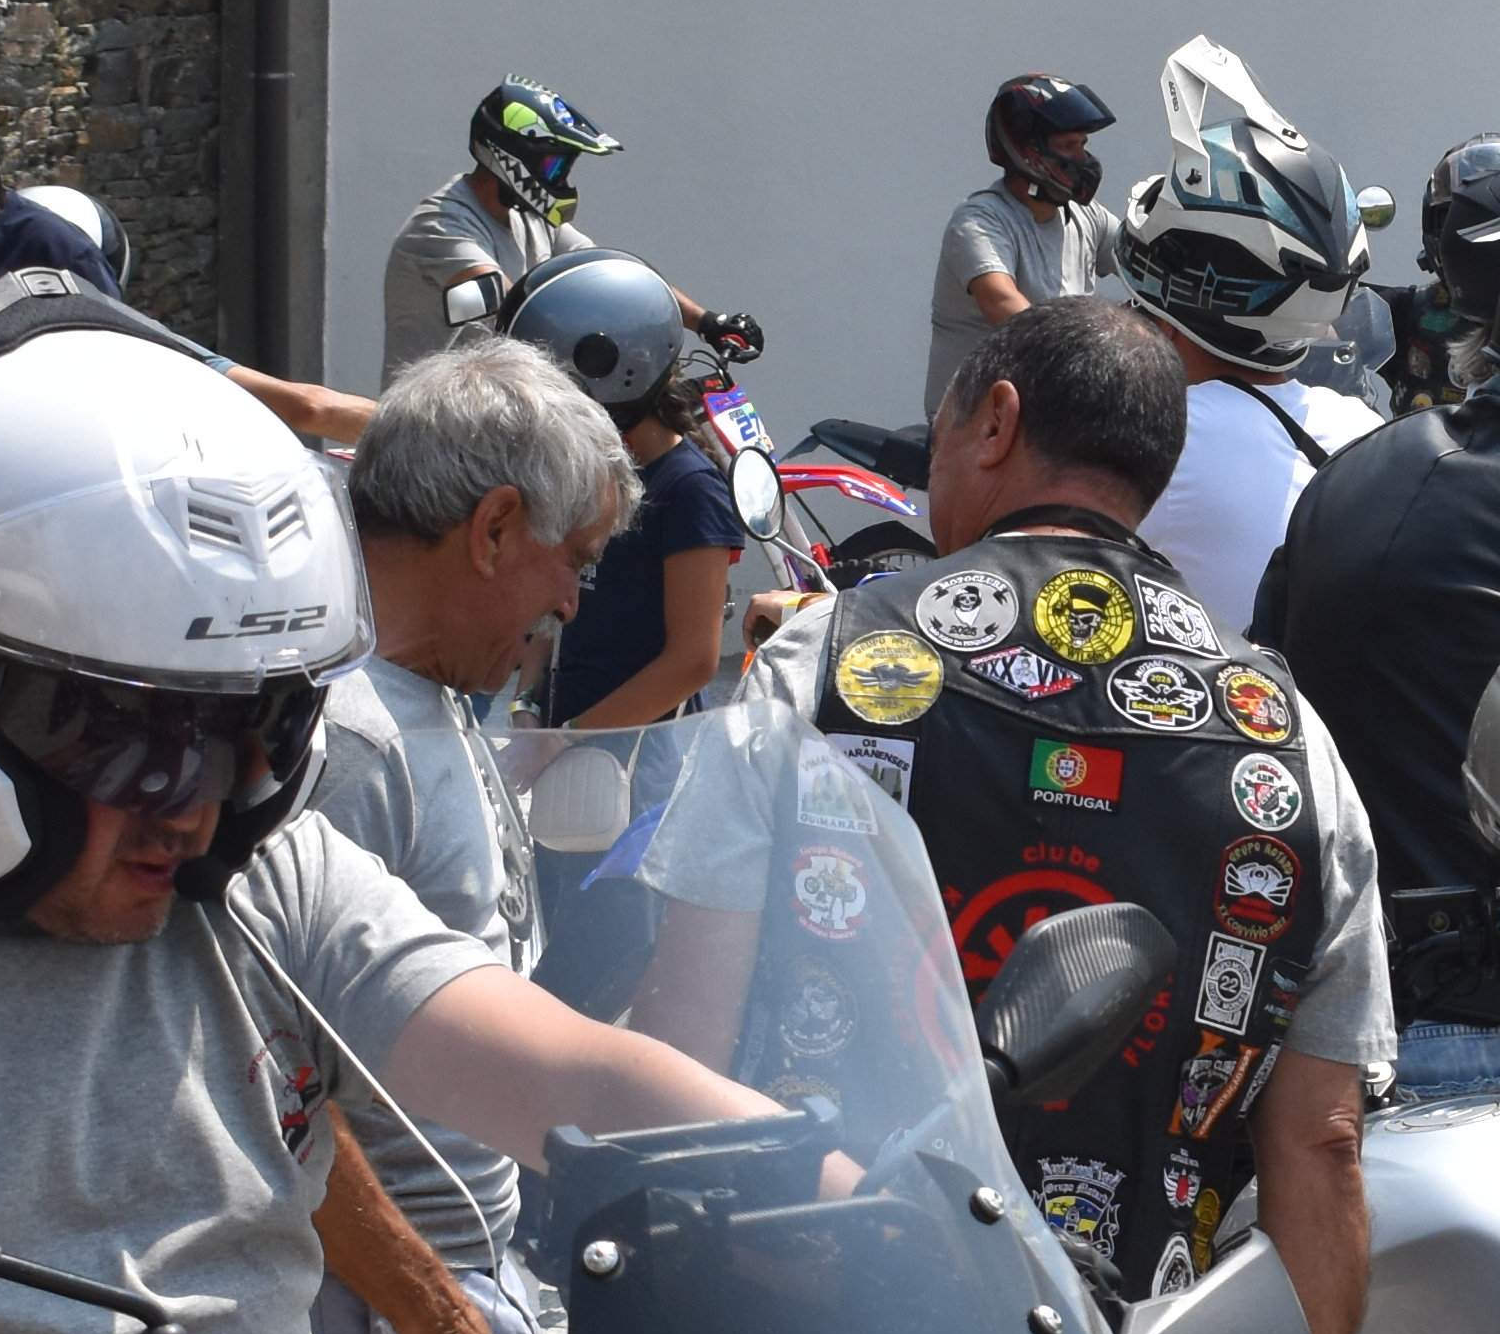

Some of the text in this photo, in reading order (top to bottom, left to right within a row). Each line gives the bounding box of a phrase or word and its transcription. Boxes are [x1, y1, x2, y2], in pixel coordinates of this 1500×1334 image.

[939, 575, 1008, 591] MOTOCLUBE
[185, 604, 328, 641] LS2
[862, 738, 877, 748] OS
[1033, 789, 1113, 812] PORTUGAL
[1022, 841, 1101, 872] clube
[1229, 842, 1261, 863] GRUPO
[1218, 974, 1240, 995] 22
